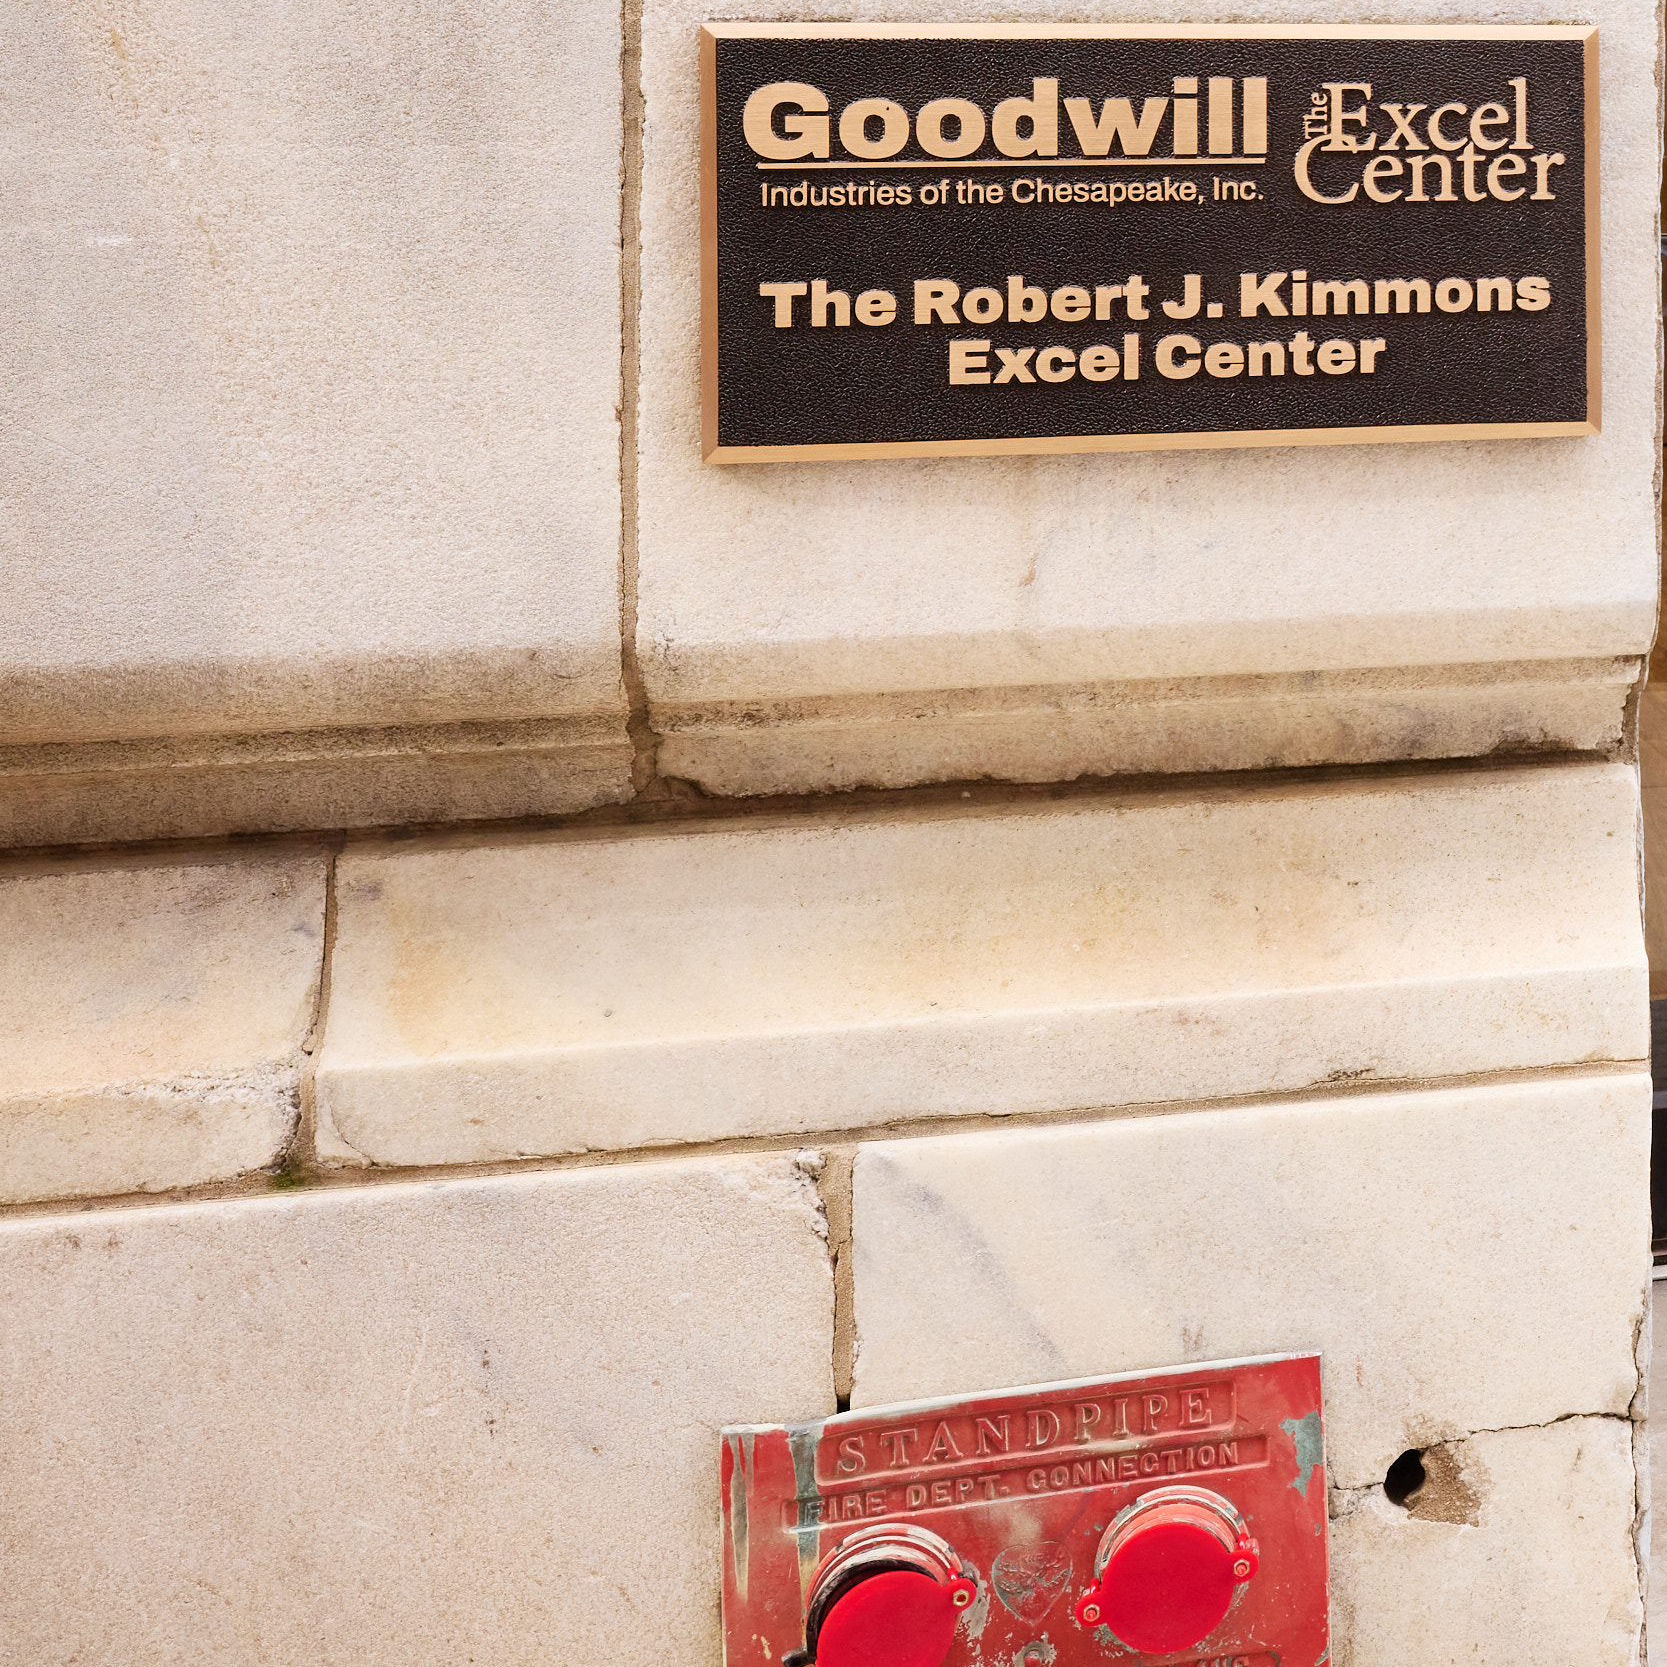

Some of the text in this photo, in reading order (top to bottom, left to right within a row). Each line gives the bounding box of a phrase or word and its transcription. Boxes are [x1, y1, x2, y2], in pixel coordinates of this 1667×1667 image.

[741, 75, 1268, 162] Goodwill
[1304, 91, 1328, 140] The
[1322, 77, 1535, 153] Excel
[759, 175, 1265, 210] Industries of the Chesapeake, Inc.
[1293, 135, 1566, 204] Center
[759, 268, 1552, 330] The Robert J. Kimmons
[949, 333, 1388, 386] Excel Center
[836, 1386, 1213, 1474] STANDPIPE
[804, 1441, 1240, 1523] FIRE DEPT. CONNECTION
